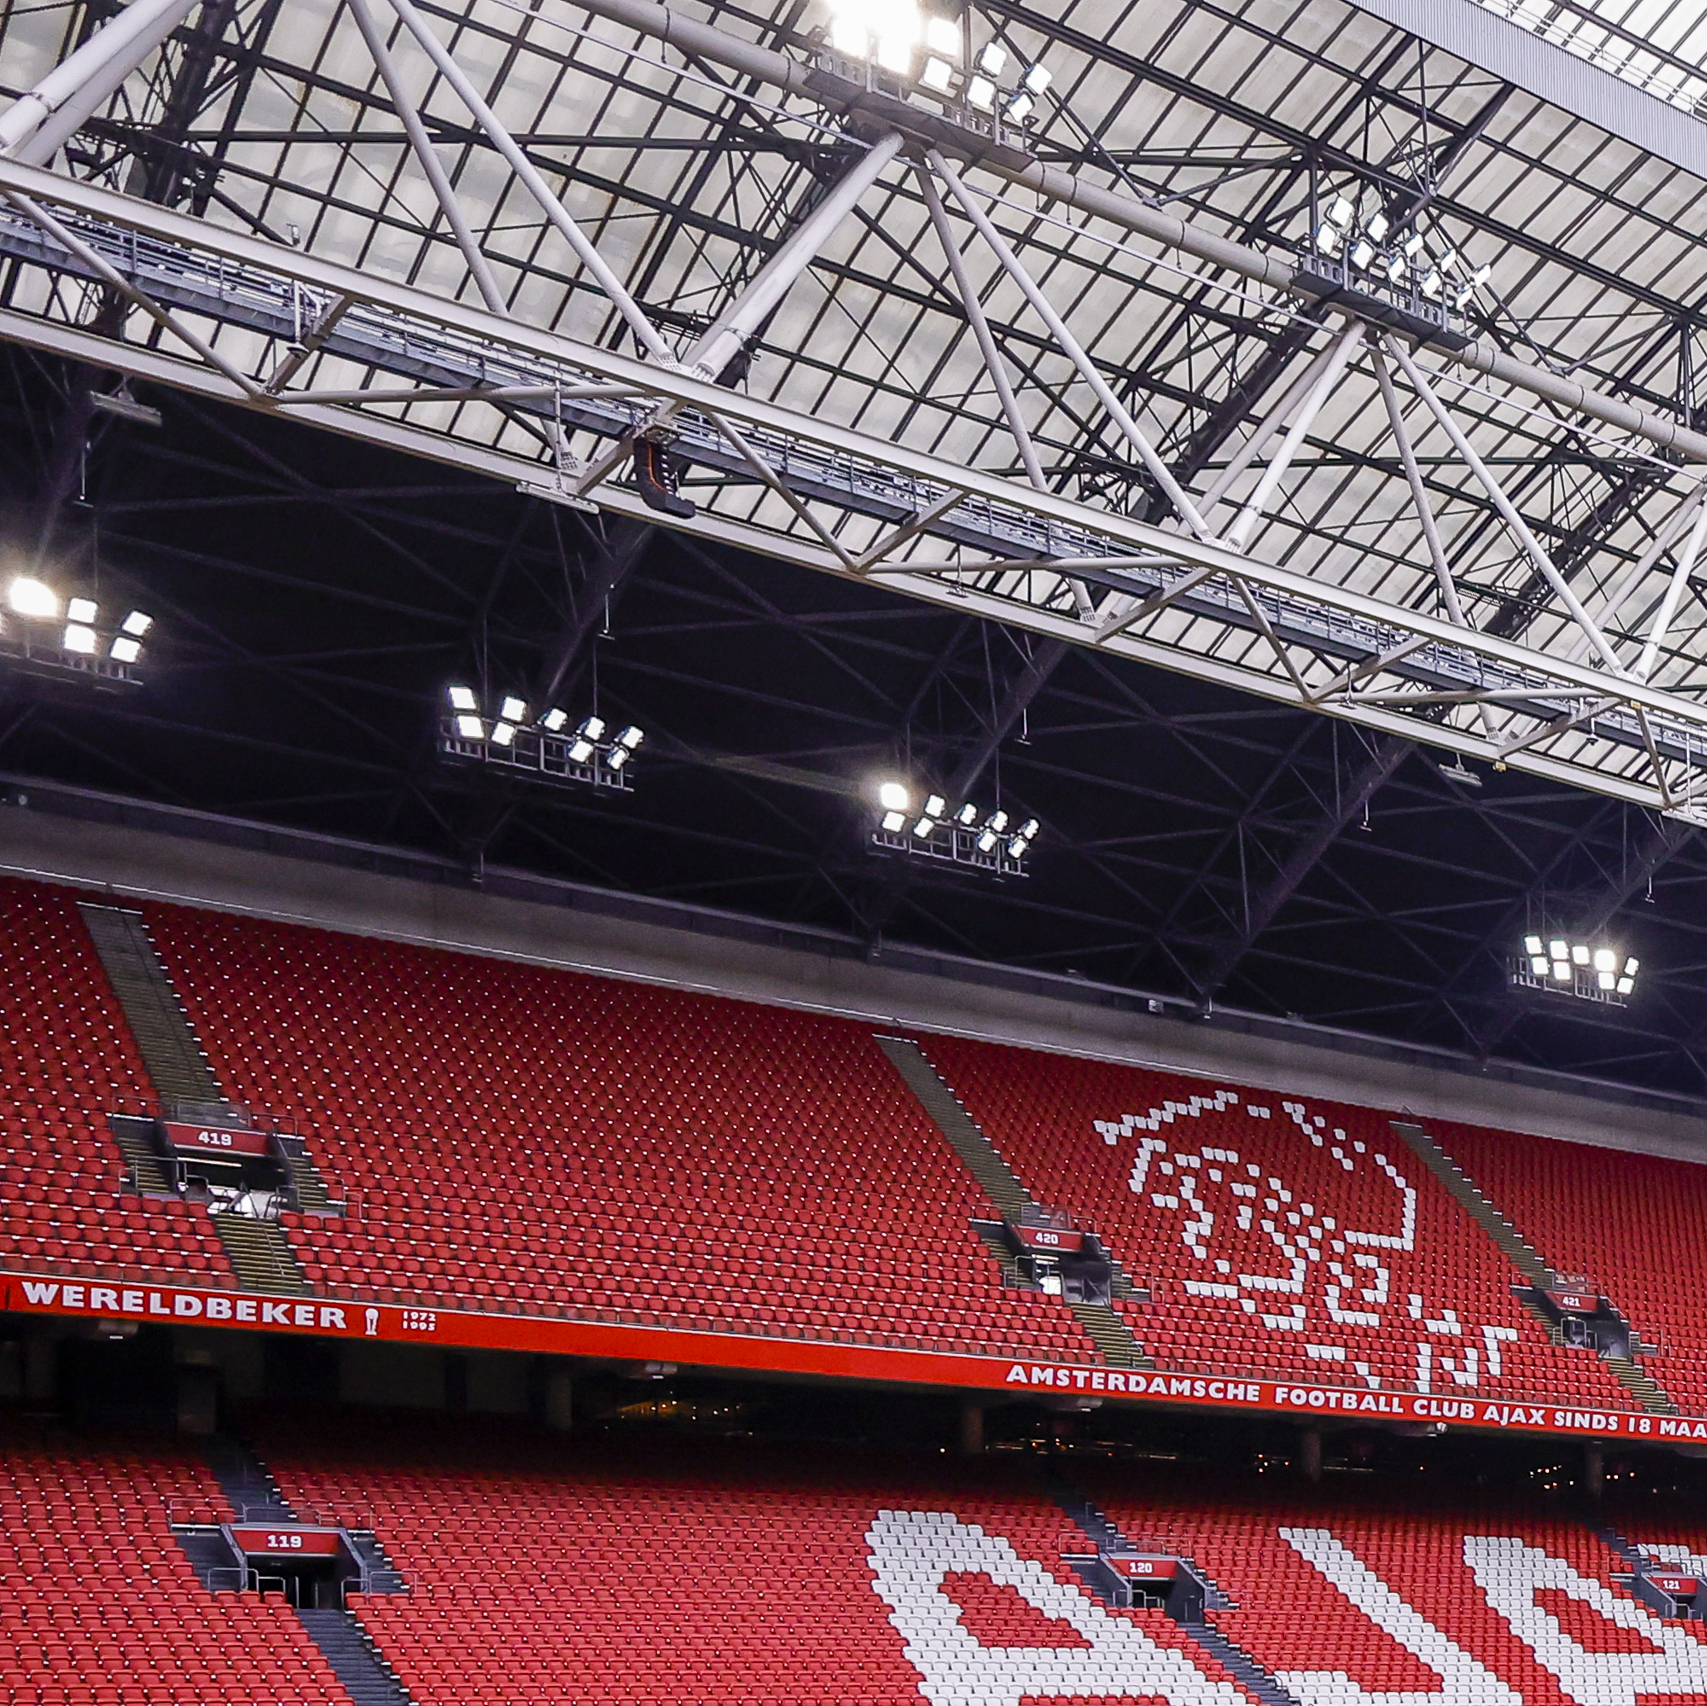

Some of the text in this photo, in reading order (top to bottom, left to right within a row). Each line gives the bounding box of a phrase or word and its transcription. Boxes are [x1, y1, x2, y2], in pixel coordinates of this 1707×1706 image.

[198, 1131, 232, 1146] 419
[1035, 1232, 1059, 1245] 420
[22, 1281, 347, 1330] WERELDBEKER
[1562, 1296, 1581, 1307] 421
[402, 1311, 437, 1322] 1972
[402, 1320, 437, 1331] 1995
[1006, 1364, 1260, 1402] AMSTERDAMSCHE
[1275, 1387, 1403, 1414] FOOTBALL
[1413, 1399, 1475, 1419] CLUB
[1483, 1406, 1546, 1426] AJAX
[1554, 1410, 1618, 1432] SINDS
[1628, 1416, 1651, 1434] 18
[267, 1535, 302, 1548] 119
[1129, 1562, 1153, 1573] 120
[1662, 1580, 1681, 1590] 121
